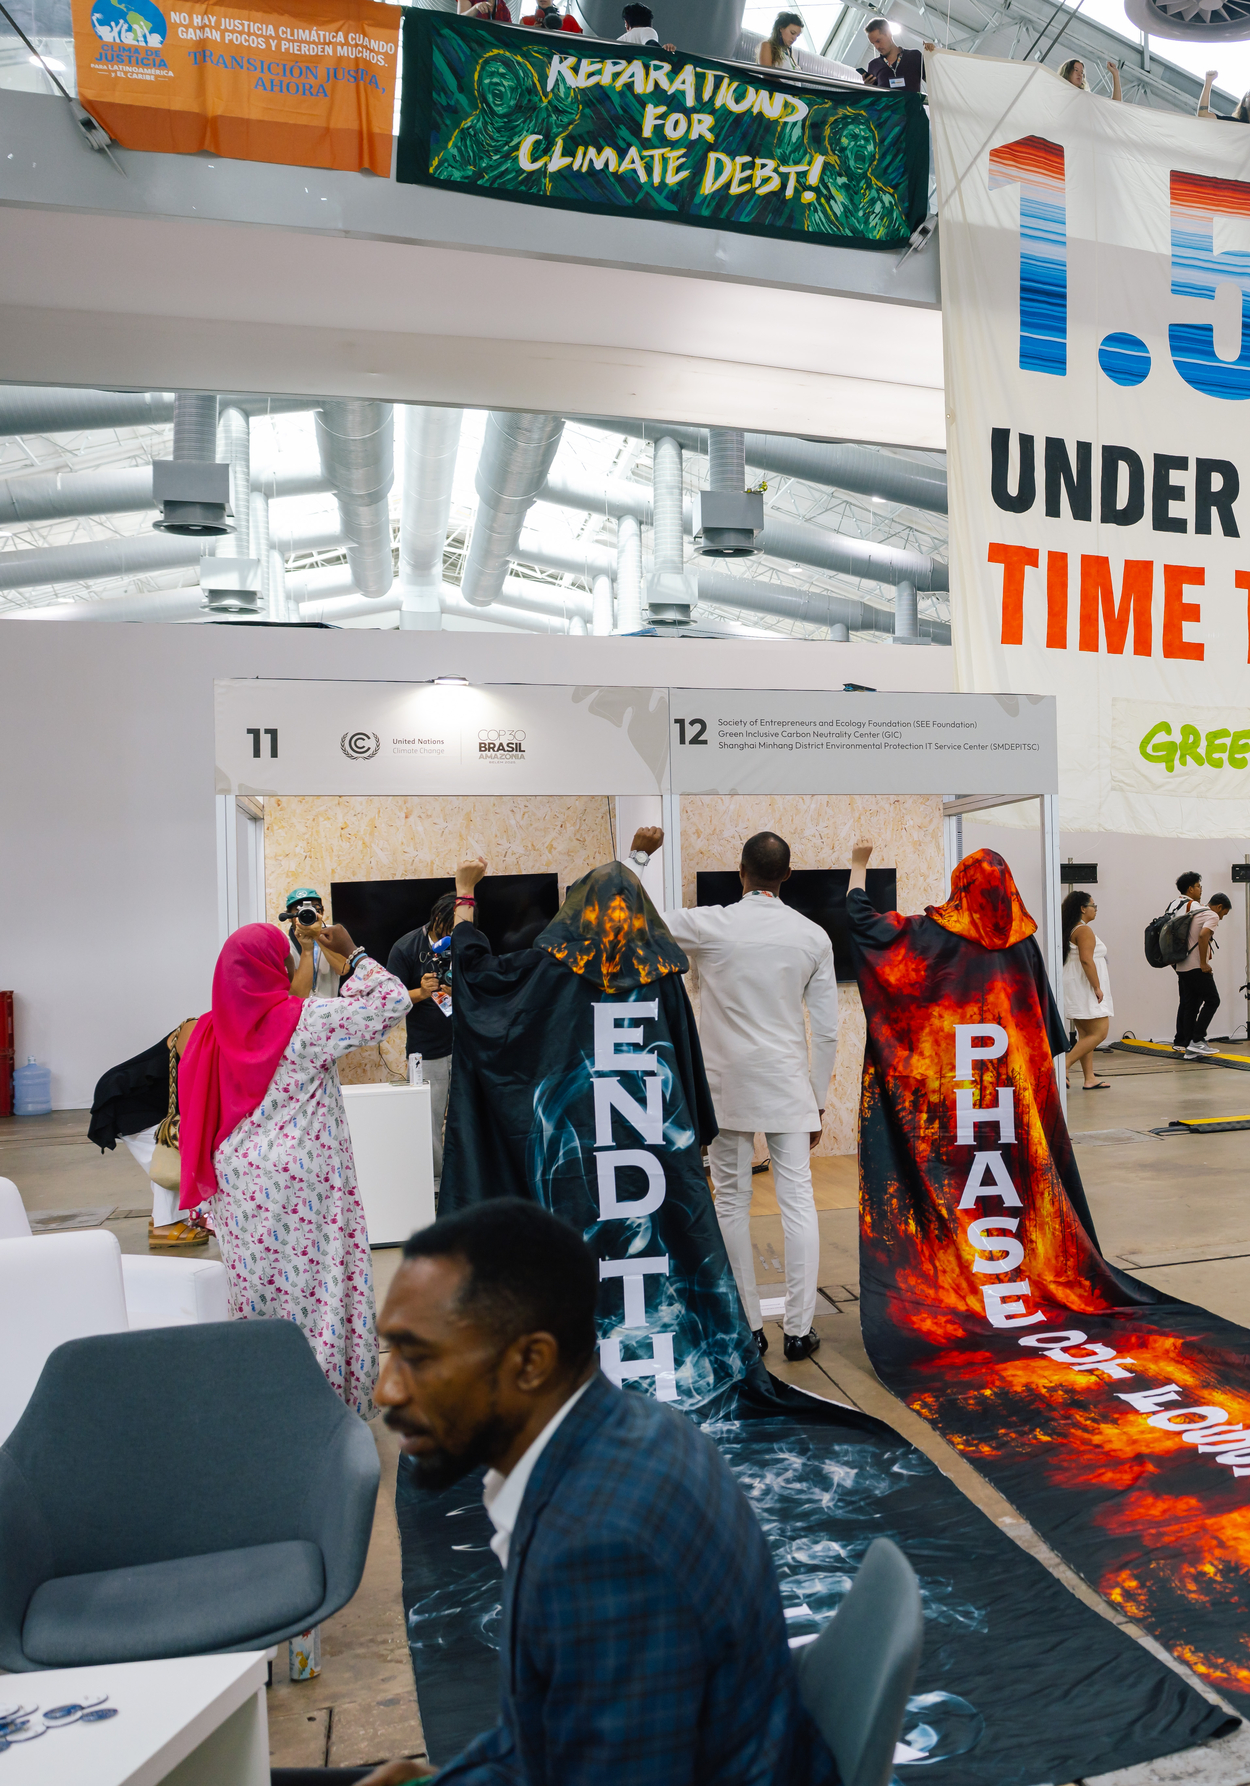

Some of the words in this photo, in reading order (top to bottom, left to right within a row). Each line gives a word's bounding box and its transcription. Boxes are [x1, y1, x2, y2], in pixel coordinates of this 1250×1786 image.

[170, 11, 189, 25] NO
[193, 14, 217, 26] HAY
[220, 17, 275, 37] JUSTICIA
[278, 26, 345, 44] CLIMÁTICA
[348, 33, 395, 54] CUANDO
[94, 52, 169, 69] JUSTICIA
[101, 44, 141, 56] CLIMA
[145, 49, 161, 58] DE
[178, 27, 220, 42] GANAN
[225, 32, 266, 49] POCOS
[269, 39, 278, 51] Y
[281, 41, 333, 56] PIERDEN
[337, 46, 389, 67] MUCHOS.
[108, 64, 174, 77] LATINOAMÉRICA
[127, 73, 155, 81] CARIBE
[188, 49, 319, 80] TRANSICIÓN
[325, 67, 386, 95] JUSTA,
[253, 76, 329, 98] AHORA
[641, 103, 715, 143] FOR
[518, 134, 692, 186] CLIMATE
[700, 152, 826, 203] DEBT!
[990, 427, 1240, 539] UNDER
[987, 541, 1205, 662] TIME
[674, 718, 708, 746] 12
[718, 718, 747, 728] Society
[750, 718, 758, 727] of
[760, 719, 817, 728] Entrepreneurs
[818, 719, 834, 727] and
[836, 720, 866, 728] Ecology
[868, 720, 912, 728] Foundation
[913, 720, 930, 728] (SEE
[932, 720, 978, 729] Foundation)
[718, 730, 744, 738] Green
[746, 730, 779, 738] Inclusive
[781, 730, 811, 738] Carbon
[813, 730, 851, 739] Neutrality
[882, 731, 902, 739] (GIC)
[246, 728, 278, 758] 11
[420, 748, 445, 756] Change
[478, 742, 526, 752] BRASIL
[718, 742, 756, 751] Shanghai
[758, 742, 793, 751] Minhang
[990, 743, 1039, 751] (SMDEPITSC)
[590, 998, 666, 1221] END
[953, 1023, 1047, 1328] PHASE
[1017, 1329, 1137, 1379] OUT
